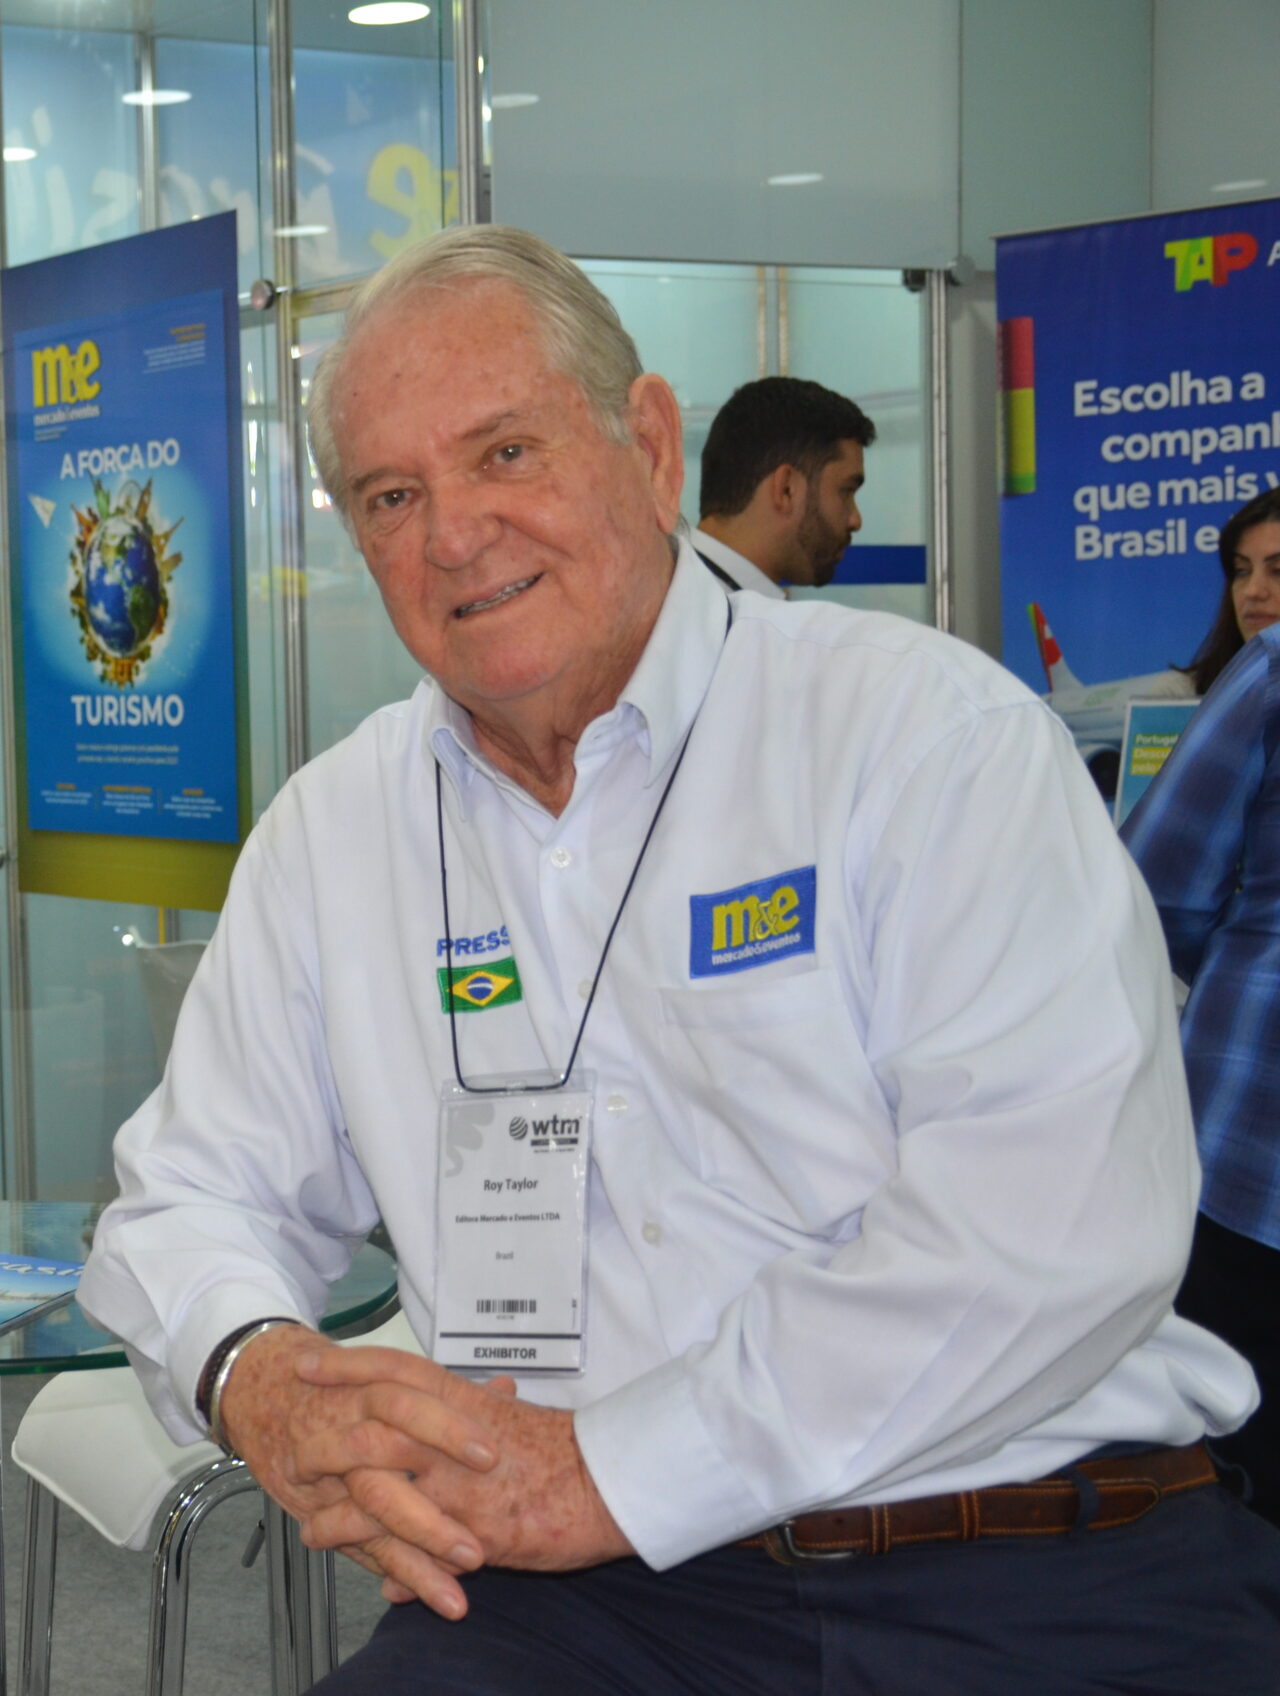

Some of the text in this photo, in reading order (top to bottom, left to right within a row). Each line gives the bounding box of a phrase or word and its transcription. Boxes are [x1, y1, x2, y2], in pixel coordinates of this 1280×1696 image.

[1164, 232, 1258, 292] TAP
[1074, 370, 1265, 417] Escolha a
[60, 438, 180, 481] A FORÇA DO
[1073, 481, 1151, 521] que
[1158, 465, 1259, 507] mais
[1075, 518, 1220, 560] Brasil e
[71, 694, 184, 727] TURISMO
[712, 886, 800, 951] m&e
[532, 1113, 580, 1135] wtm
[483, 1177, 538, 1194] Roy Taylor
[541, 1211, 560, 1221] LTDA
[473, 1346, 537, 1359] EXHIBITOR
